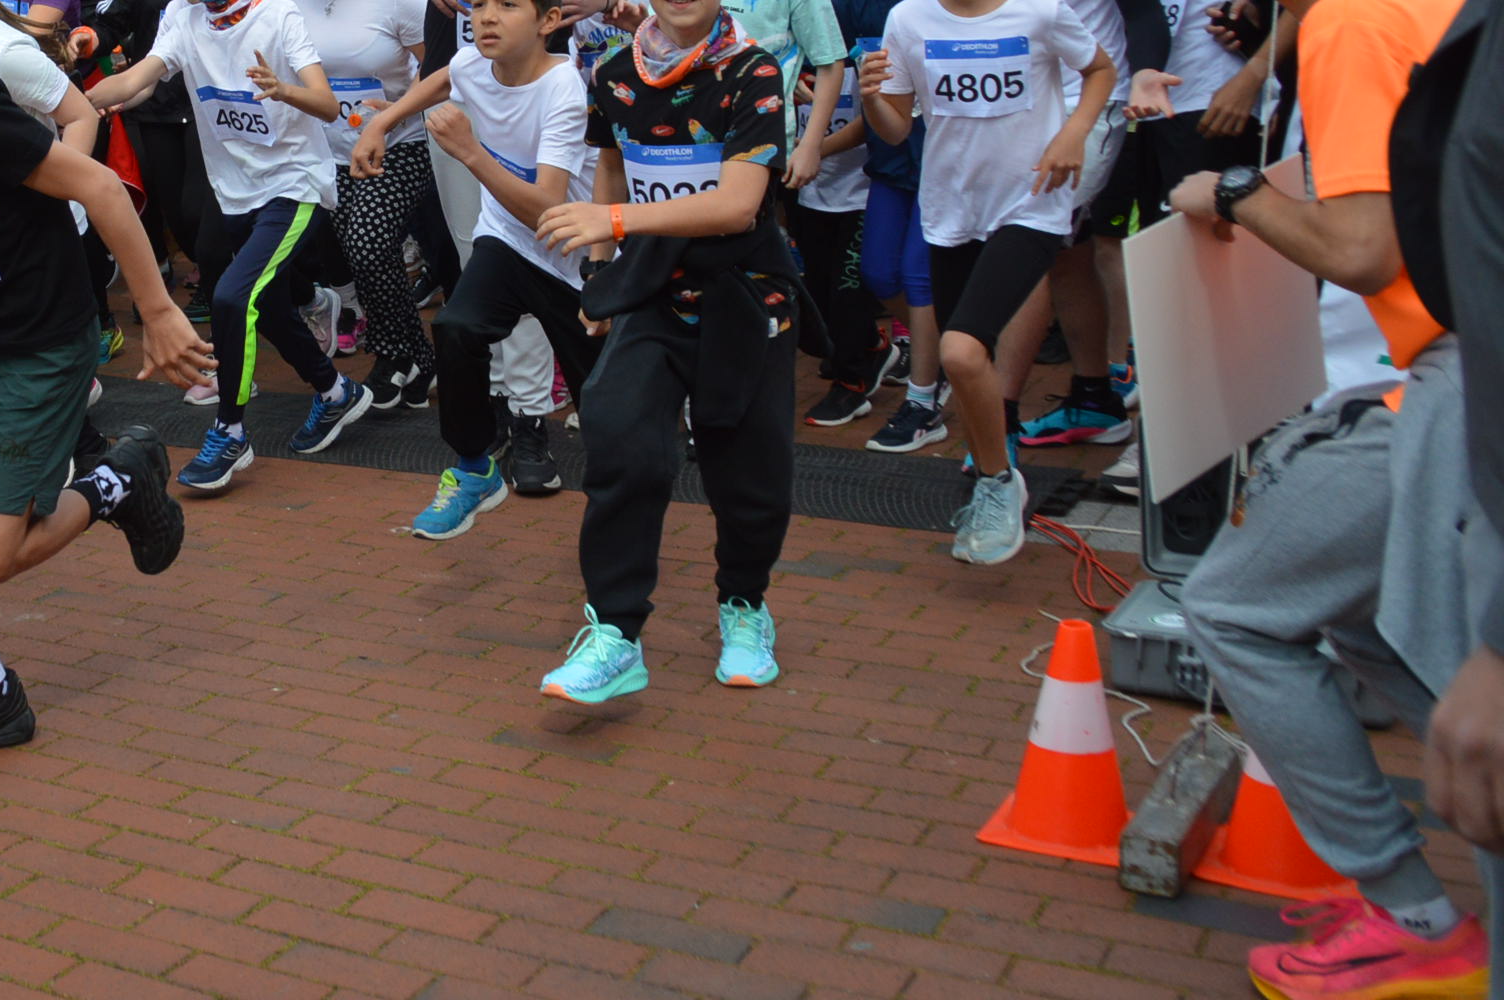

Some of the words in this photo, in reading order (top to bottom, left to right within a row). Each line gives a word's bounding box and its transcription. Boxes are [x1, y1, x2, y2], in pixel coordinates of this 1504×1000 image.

[935, 70, 1024, 103] 4805
[216, 108, 269, 135] 4625
[650, 147, 693, 156] DECATHLON
